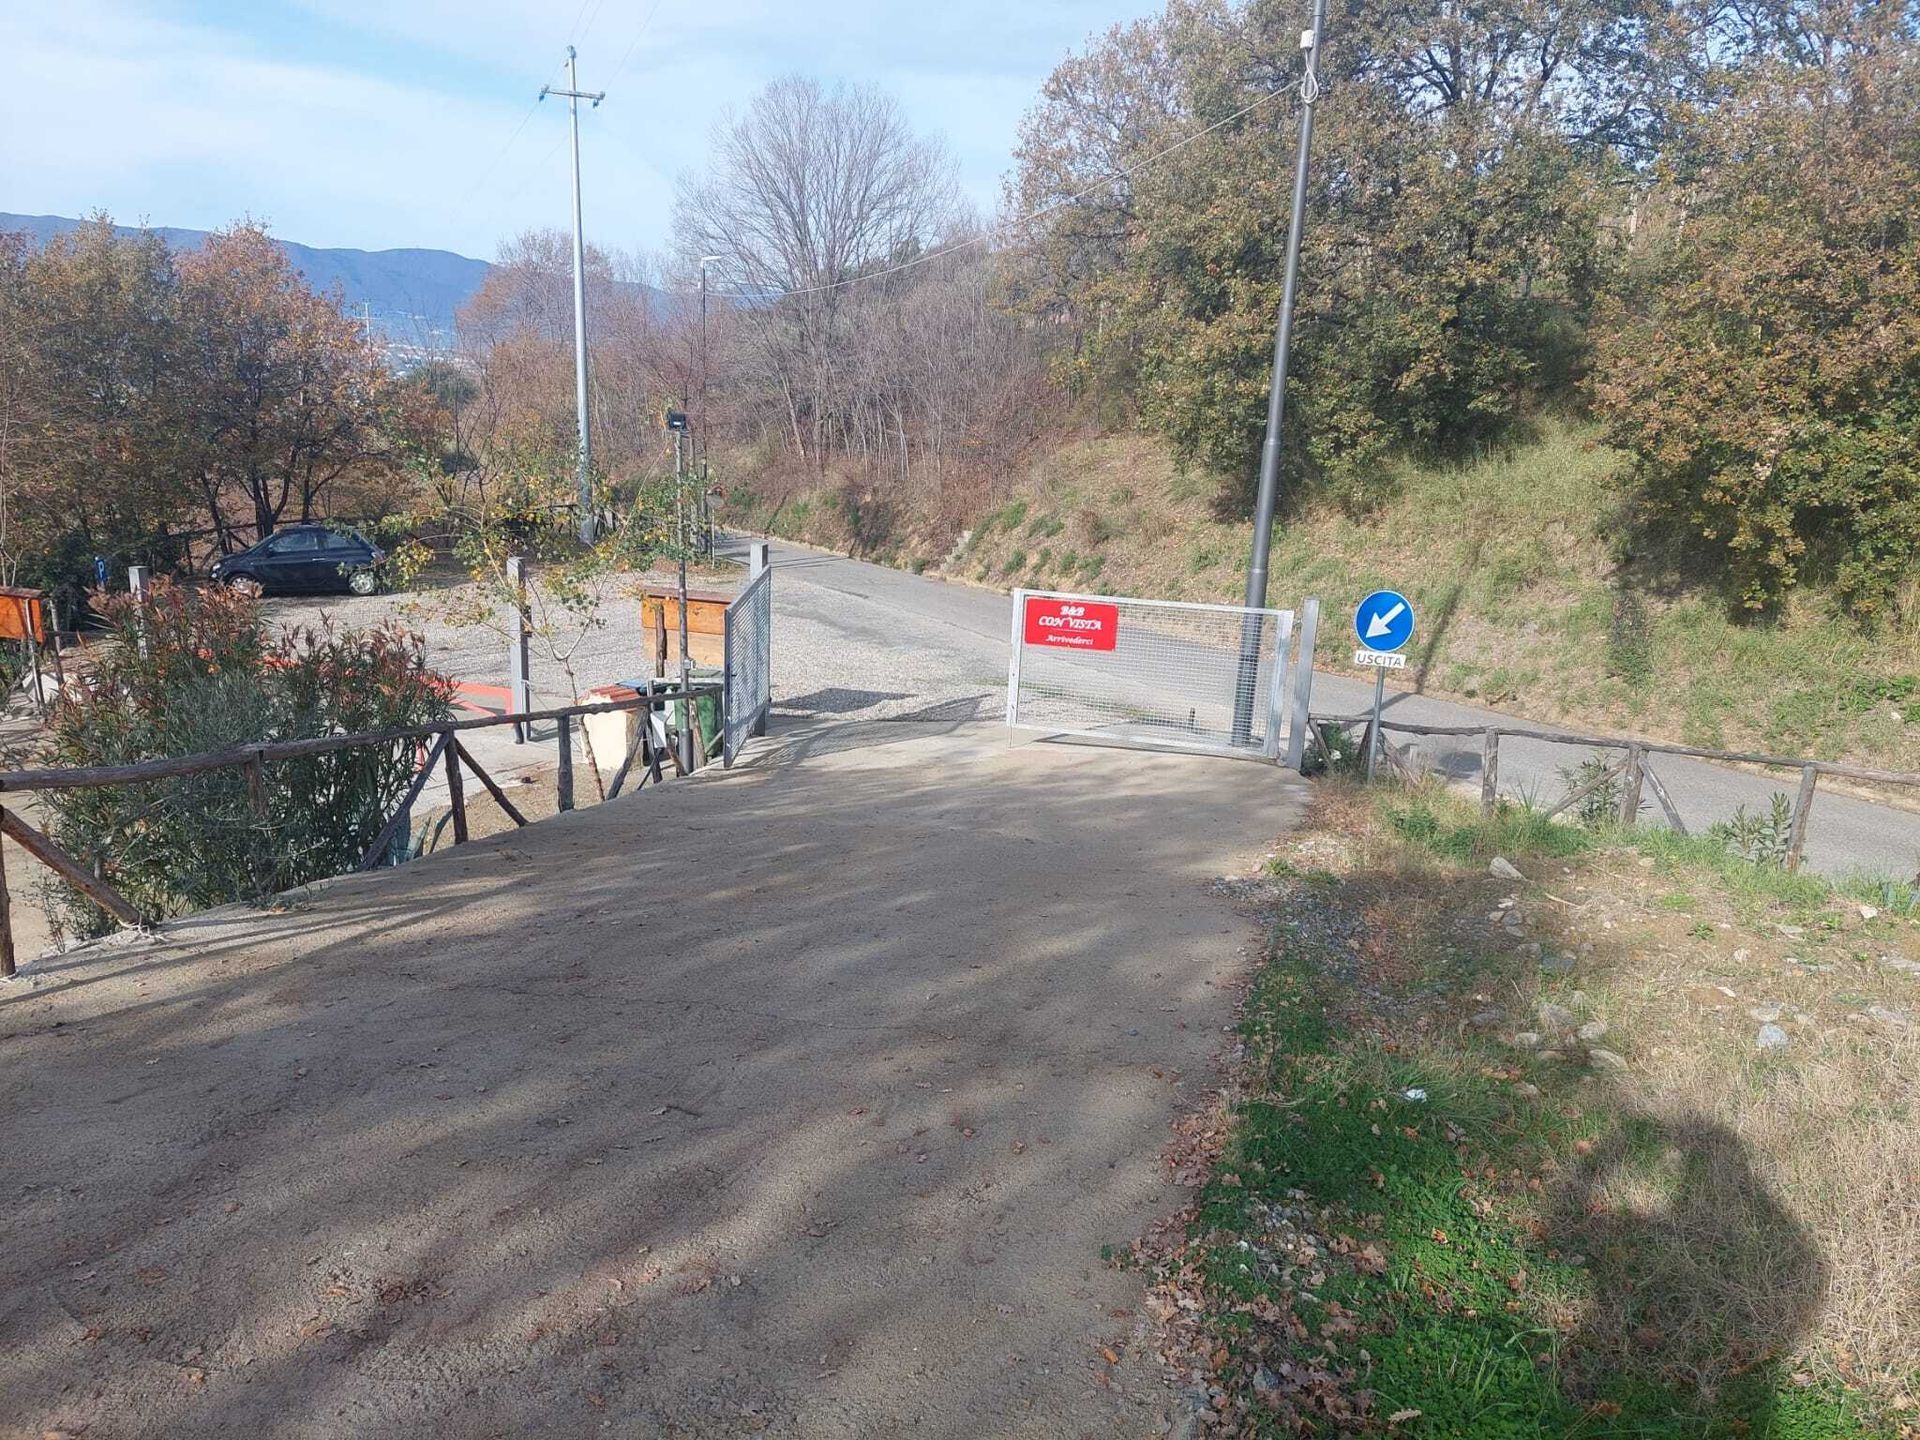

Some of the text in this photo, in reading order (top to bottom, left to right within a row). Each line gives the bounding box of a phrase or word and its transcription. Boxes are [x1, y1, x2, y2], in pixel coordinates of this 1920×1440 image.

[98, 561, 105, 578] P
[1060, 606, 1085, 616] B&B
[1038, 616, 1102, 630] CON VISTA
[1046, 634, 1094, 645] Arrivederci
[1357, 653, 1401, 666] USCITA
